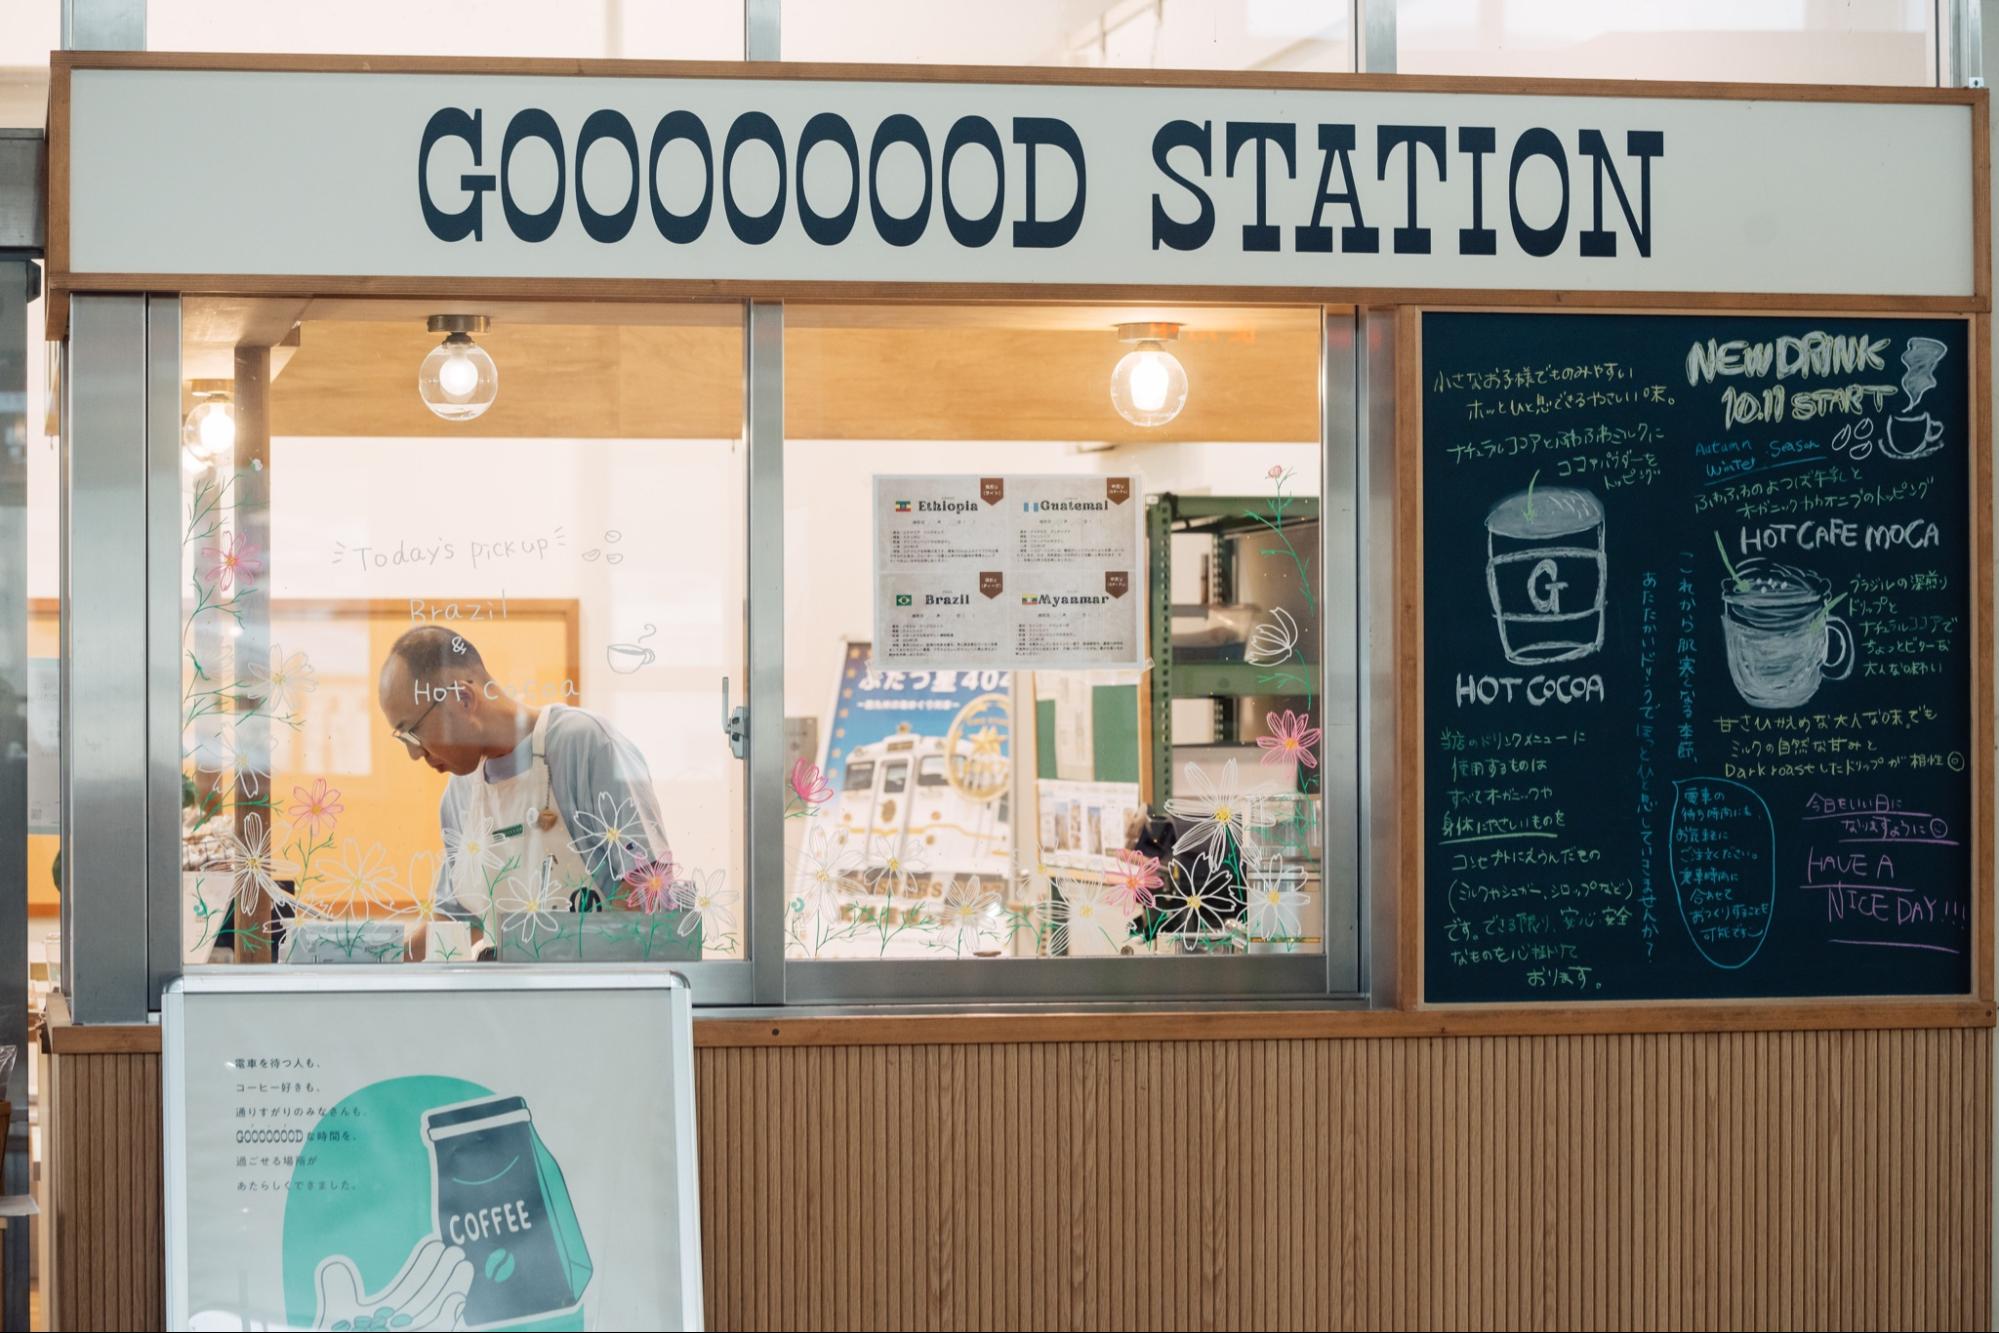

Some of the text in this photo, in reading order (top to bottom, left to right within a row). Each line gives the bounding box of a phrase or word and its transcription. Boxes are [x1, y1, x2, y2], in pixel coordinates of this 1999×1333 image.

[418, 106, 1664, 258] GOOOOOOOD STATION
[1686, 330, 1891, 387] NEW DRINK
[1791, 383, 1898, 421] START
[1695, 439, 1821, 458] Autumn Season
[1604, 469, 1661, 491] トッピング
[918, 500, 978, 514] Ethiopia
[1741, 519, 1940, 554] HOT CAFE MOCA
[353, 537, 455, 571] Today's
[1527, 558, 1569, 614] G
[409, 589, 508, 625] Brazil
[925, 594, 970, 605] Brazil
[1039, 594, 1109, 607] Myanmar
[1849, 597, 1898, 616] ドリップと
[451, 636, 467, 655] &
[414, 679, 465, 704] Hot
[1456, 673, 1523, 708] HOT
[1451, 756, 1548, 782] 使用するものは
[1725, 763, 1767, 778] Dark
[1808, 846, 1894, 883] HAVE A
[1827, 881, 1889, 922] NICE
[235, 1058, 321, 1069] 電車を待つ人も、
[236, 1082, 321, 1093] コーヒー好きも、
[236, 1156, 318, 1167] 過ごせる場所が
[237, 1180, 357, 1191] あたらしくできました。
[449, 1199, 532, 1246] COFFEE
